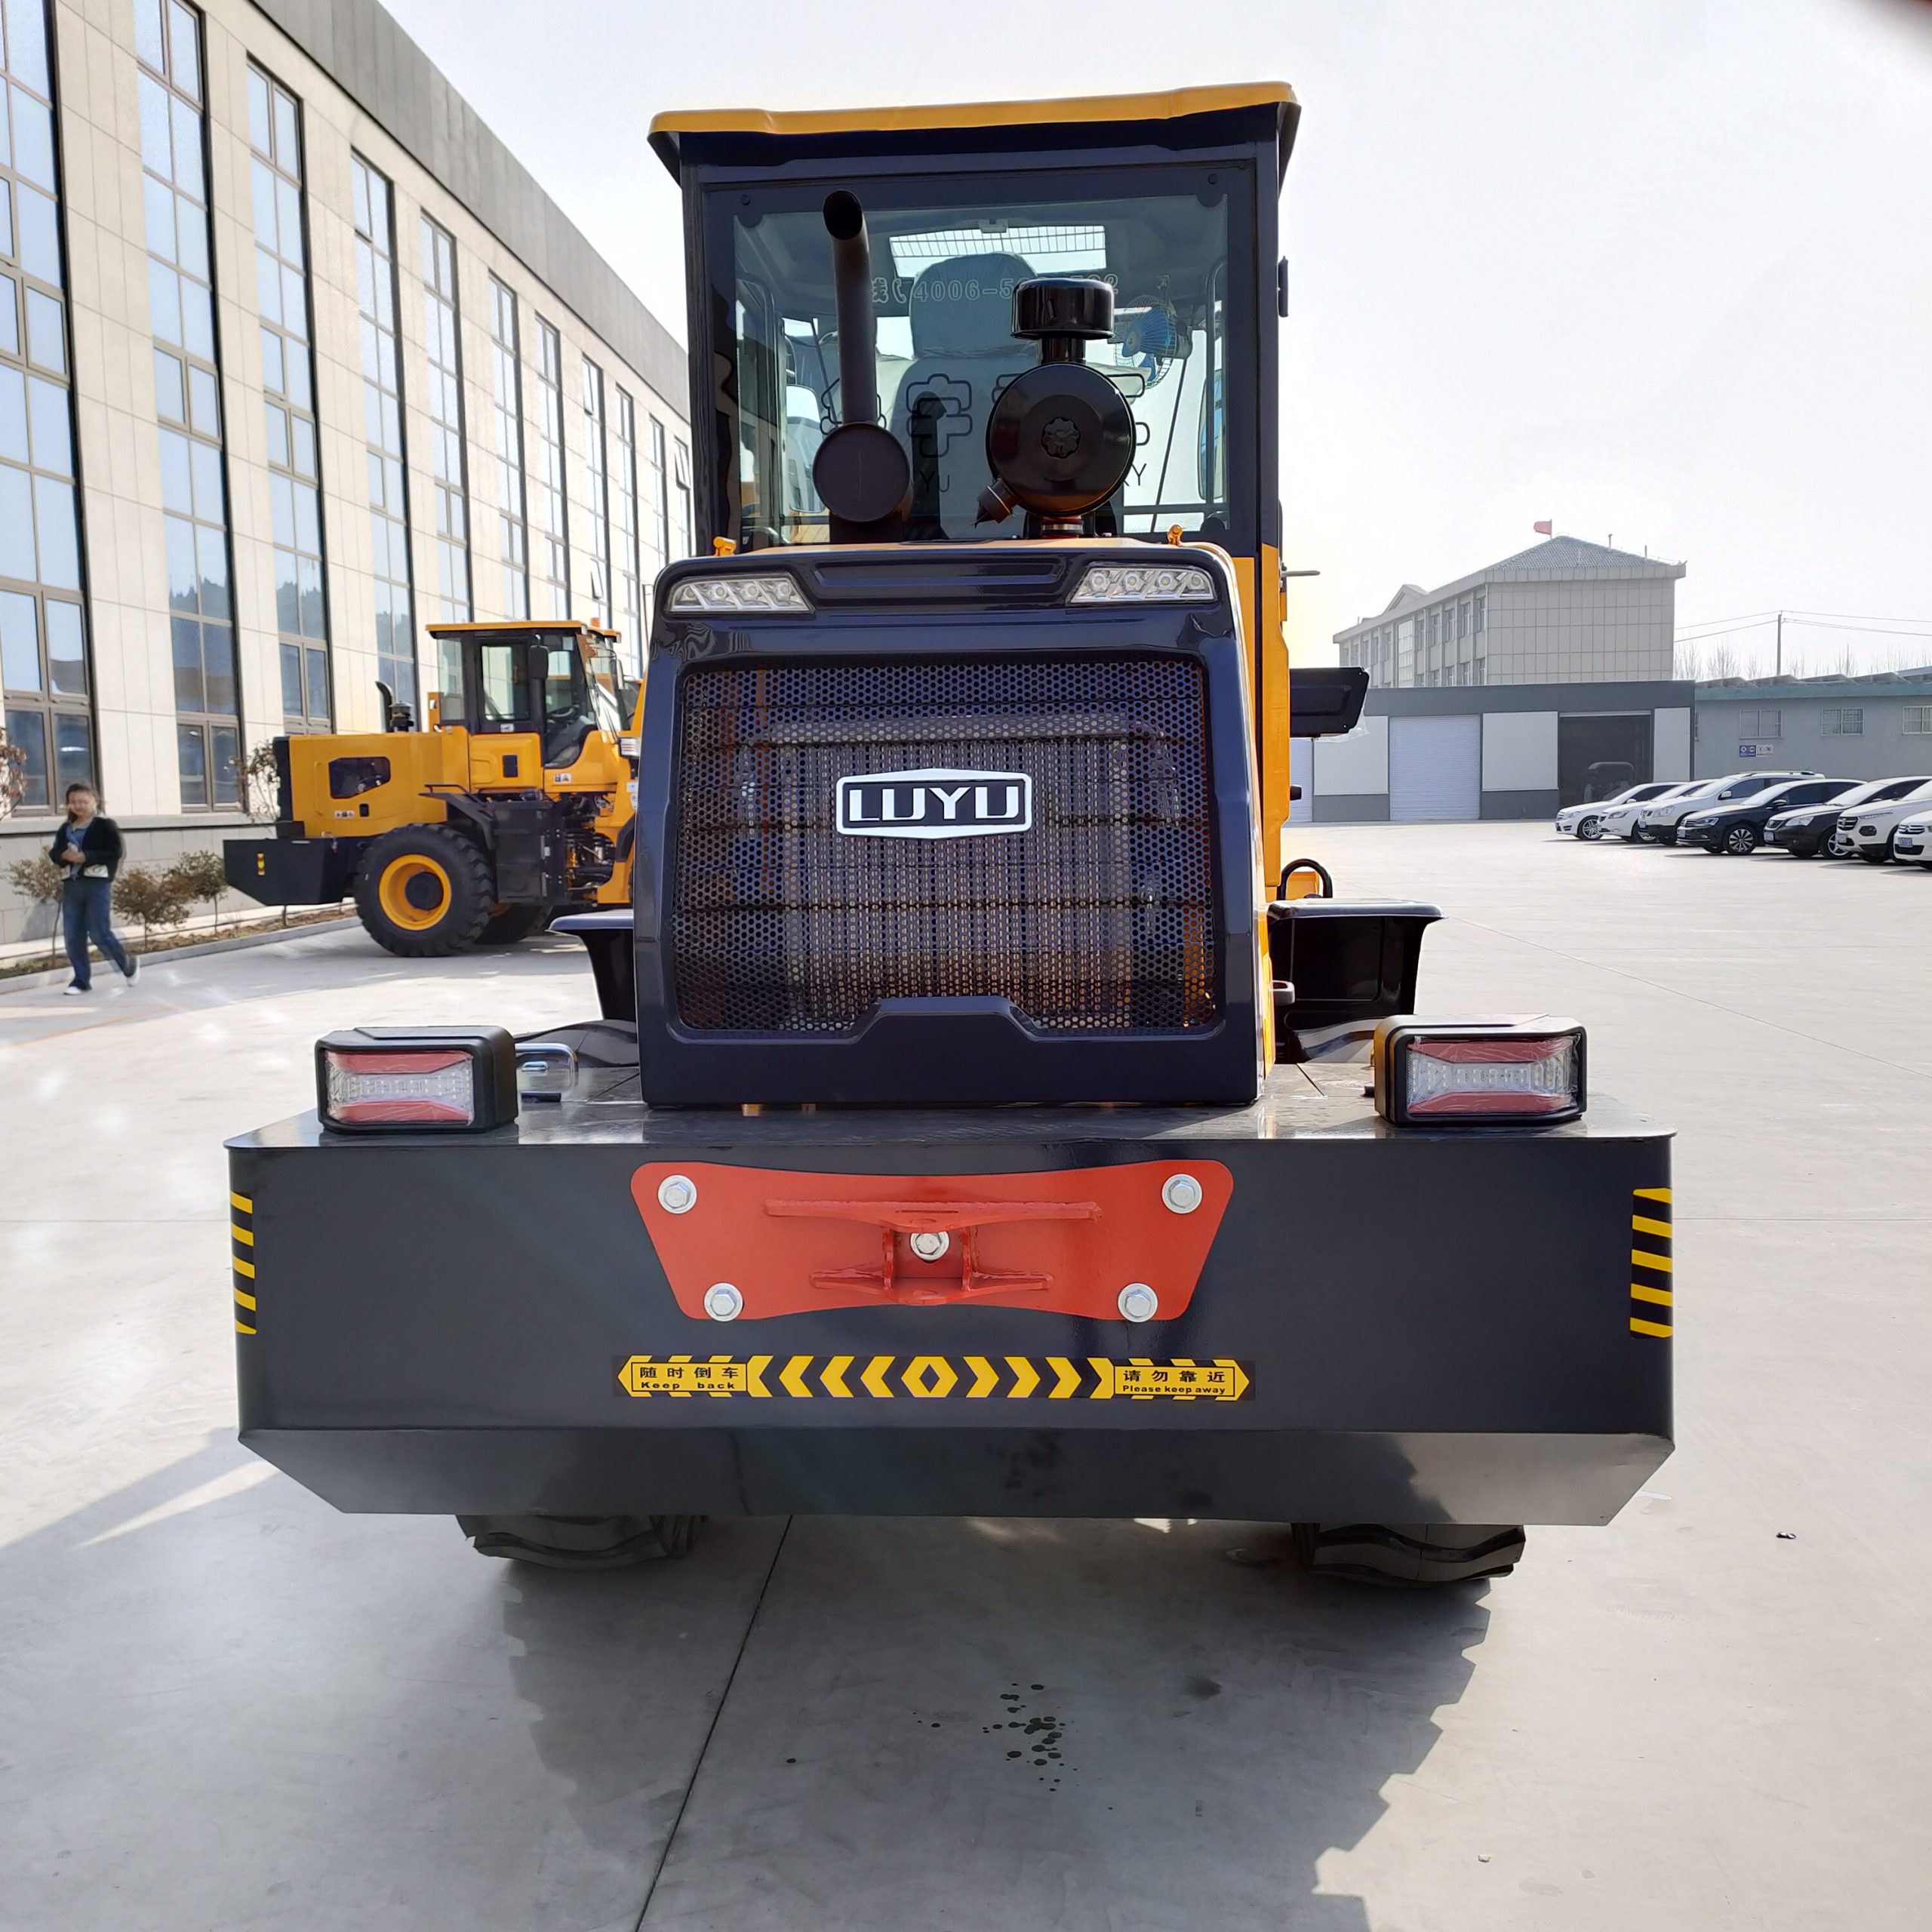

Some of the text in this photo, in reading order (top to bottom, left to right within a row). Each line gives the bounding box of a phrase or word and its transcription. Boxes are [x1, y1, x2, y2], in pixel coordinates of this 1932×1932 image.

[848, 786, 1019, 822] LUYU
[639, 1366, 739, 1379] 随时倒车
[1123, 1370, 1226, 1383] 请勿靠近
[641, 1381, 680, 1390] Keep
[1164, 1386, 1192, 1394] keep
